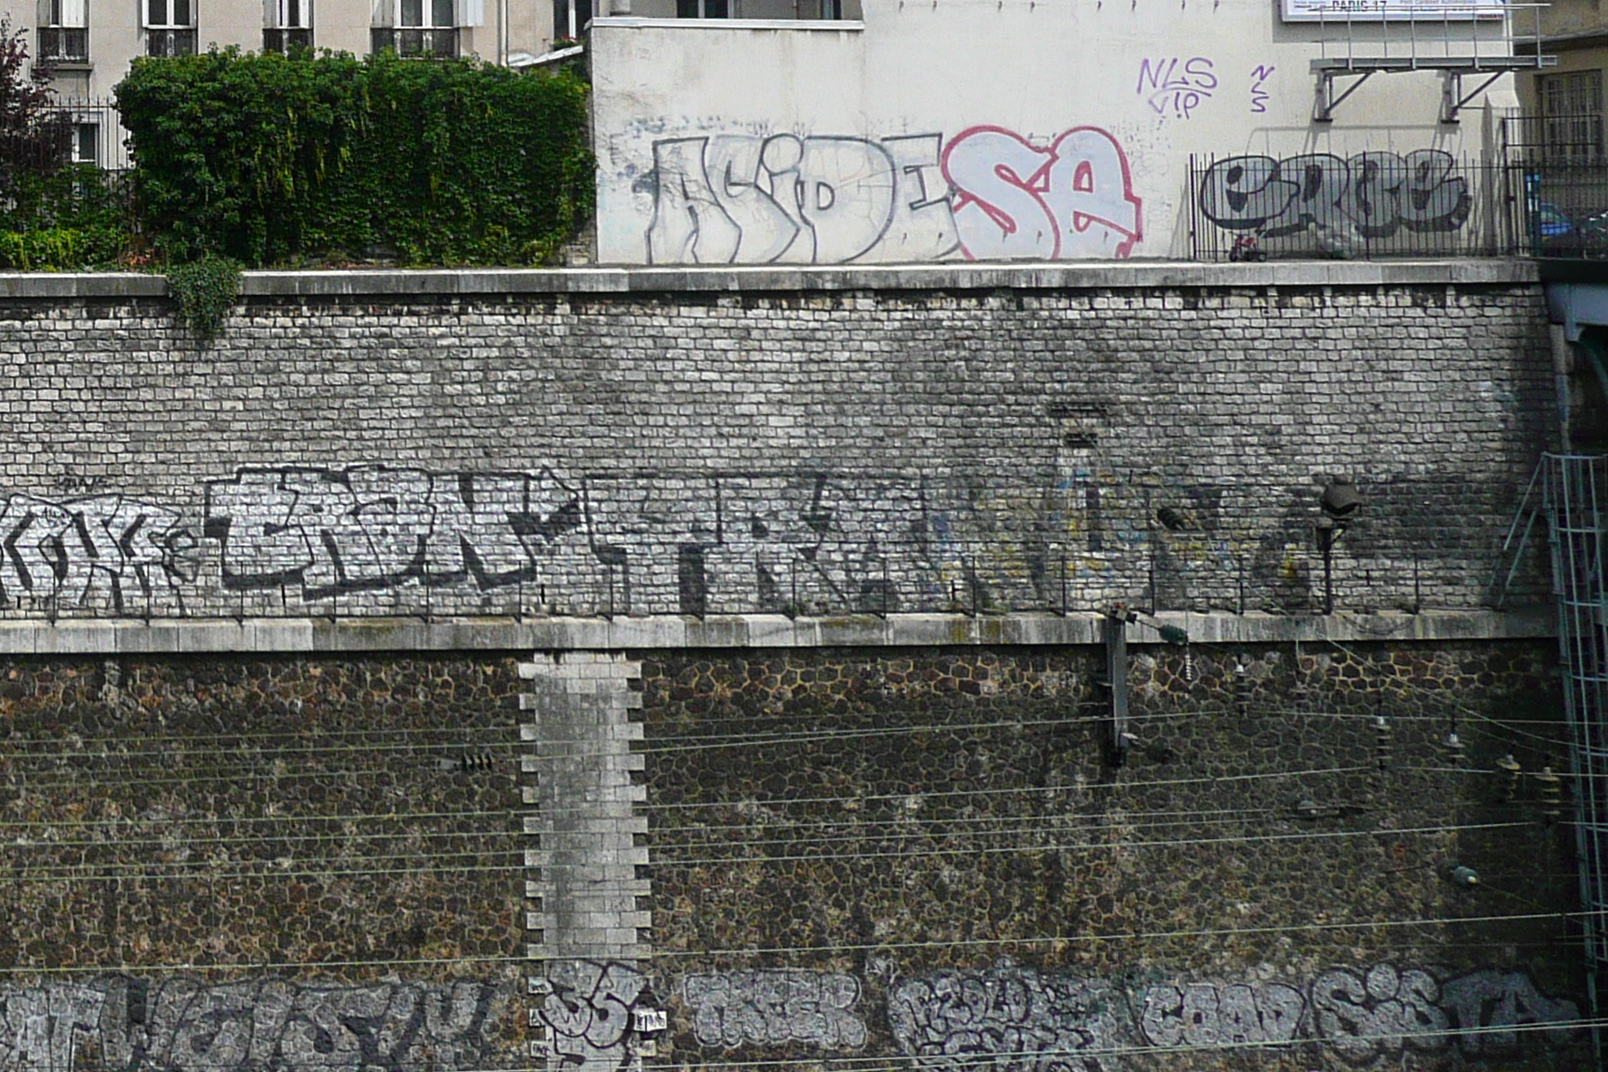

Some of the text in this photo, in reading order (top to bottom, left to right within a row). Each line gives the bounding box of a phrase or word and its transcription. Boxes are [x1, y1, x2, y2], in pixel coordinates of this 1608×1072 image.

[1332, 0, 1368, 12] PARIS
[1373, 0, 1387, 12] 17
[1137, 57, 1218, 94] NLS
